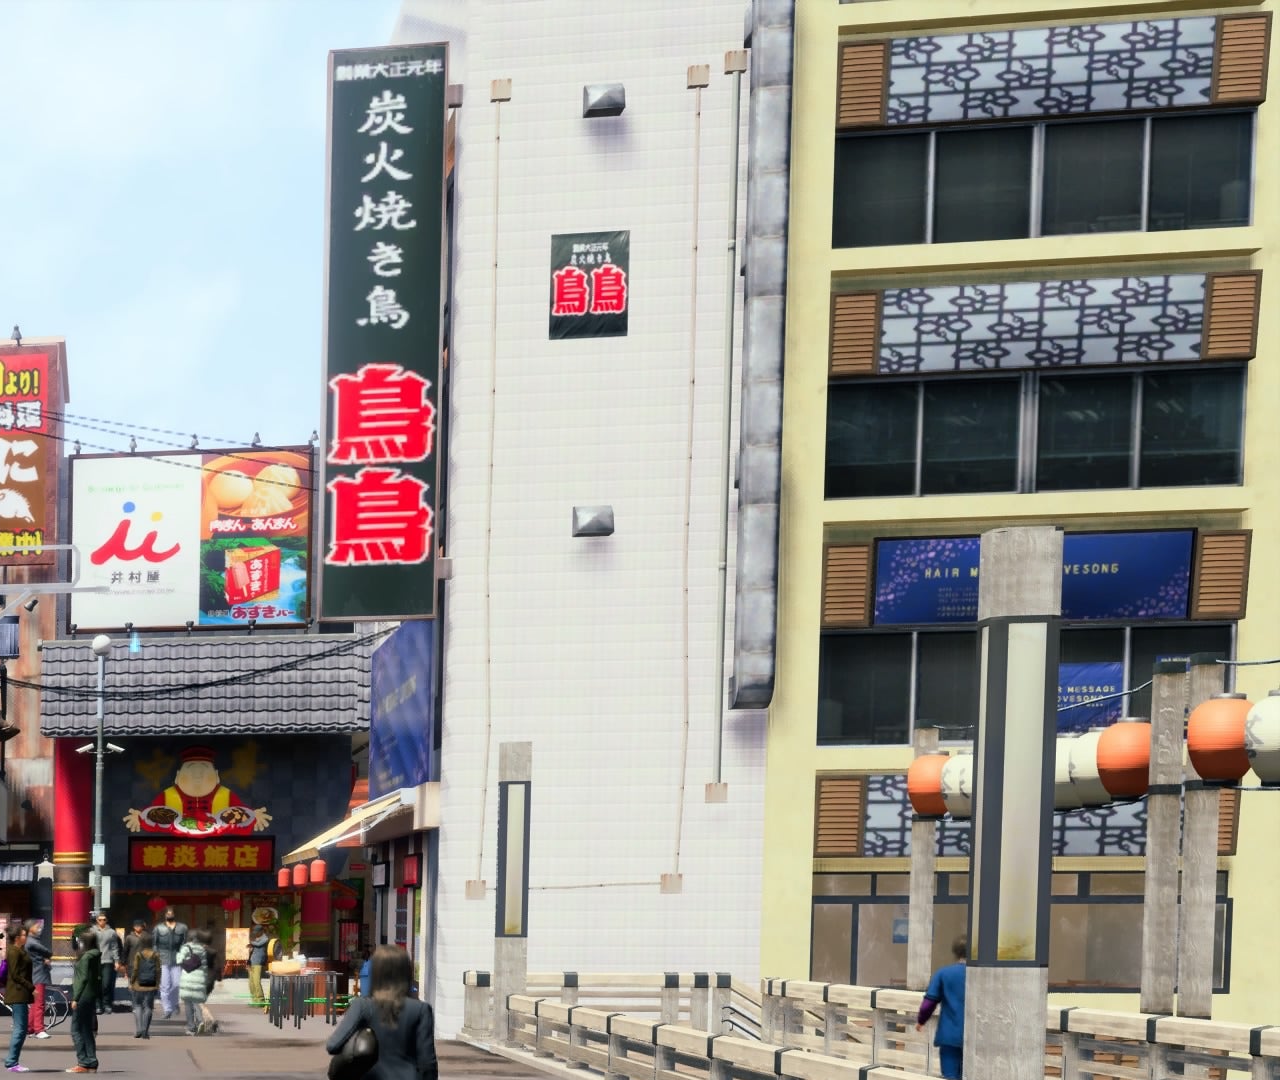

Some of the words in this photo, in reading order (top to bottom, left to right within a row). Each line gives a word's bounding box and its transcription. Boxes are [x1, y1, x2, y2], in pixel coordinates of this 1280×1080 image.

[353, 89, 417, 330] 炭火焼き鳥
[924, 569, 960, 578] HAIR
[1063, 563, 1119, 575] VESONG
[1067, 685, 1116, 693] MESSAGE
